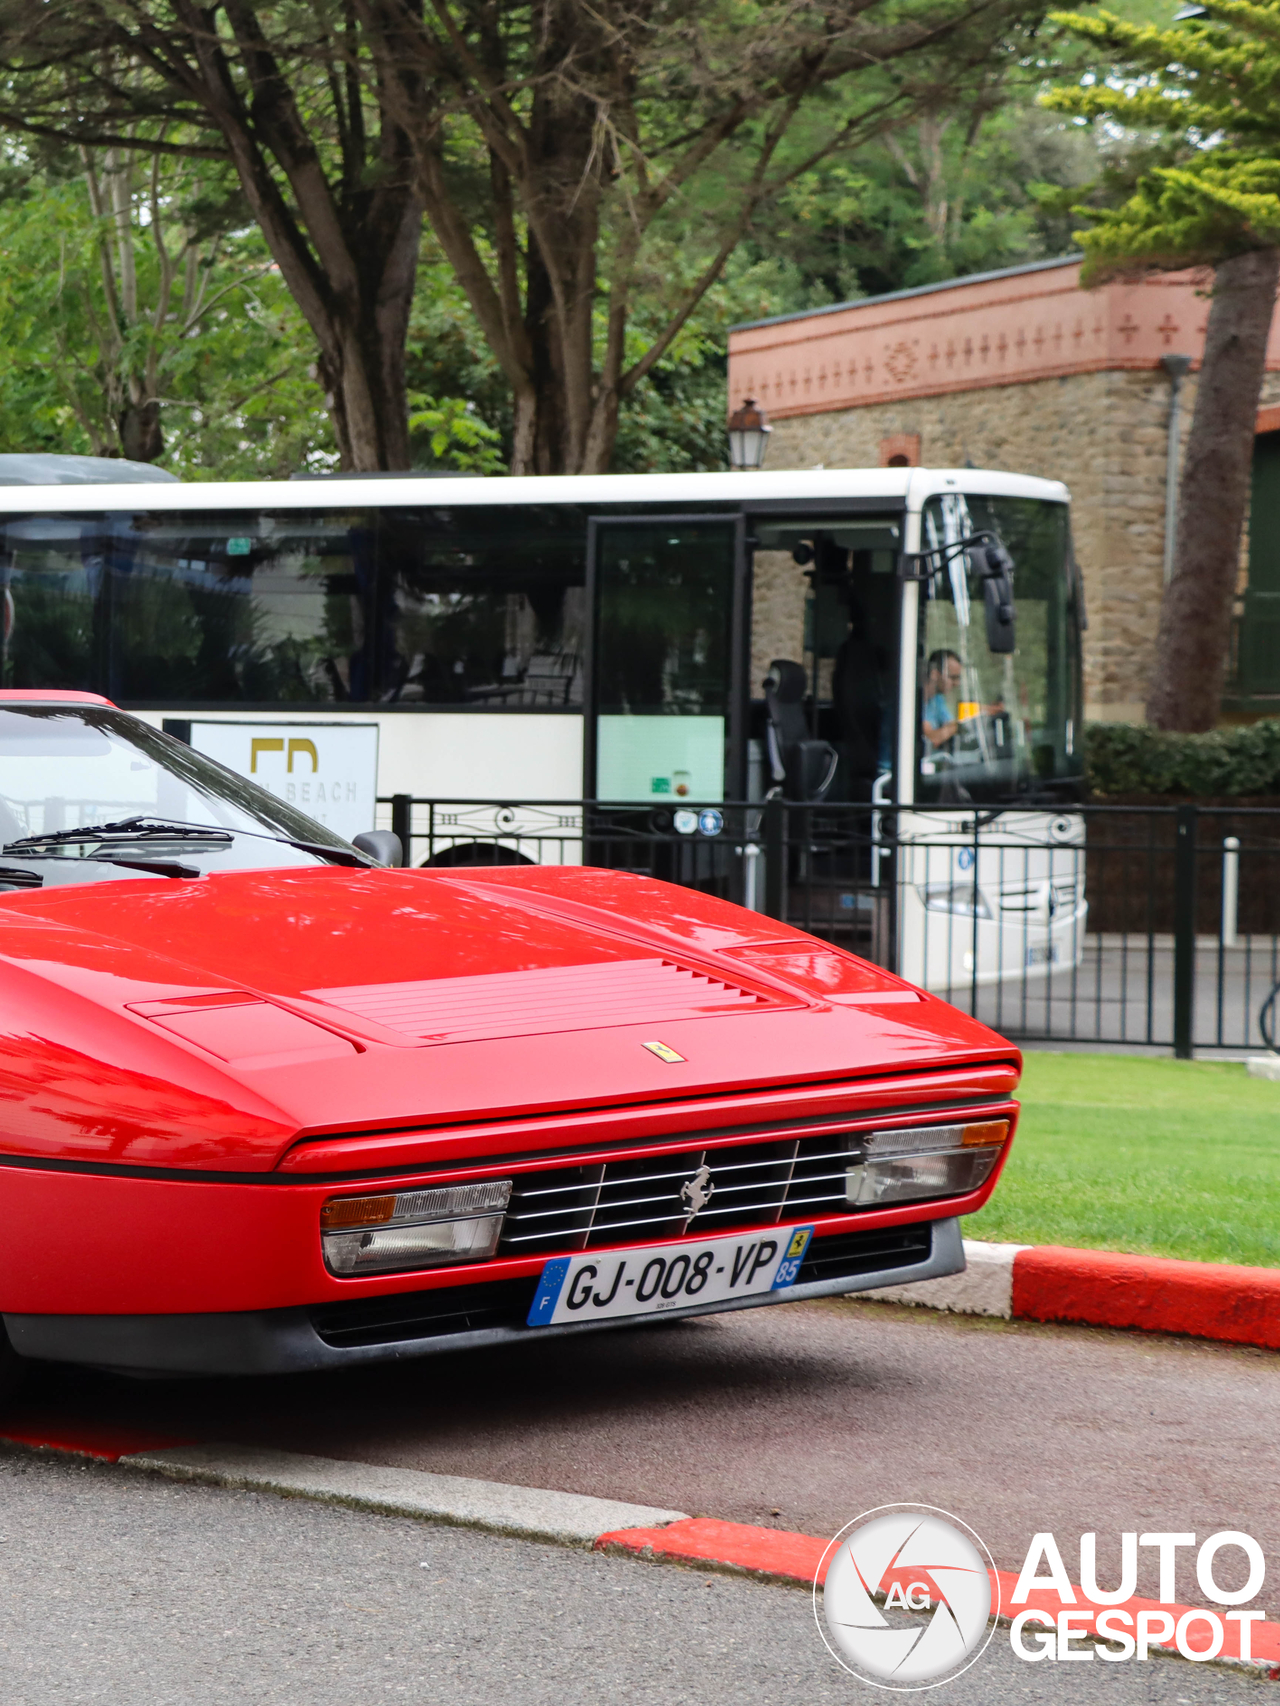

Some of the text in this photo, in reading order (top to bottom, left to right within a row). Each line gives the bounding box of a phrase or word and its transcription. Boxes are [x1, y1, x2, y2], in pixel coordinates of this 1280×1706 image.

[286, 781, 357, 803] BEACH
[566, 1240, 778, 1310] GJ-008-VP
[775, 1259, 801, 1284] 85
[539, 1296, 551, 1310] F
